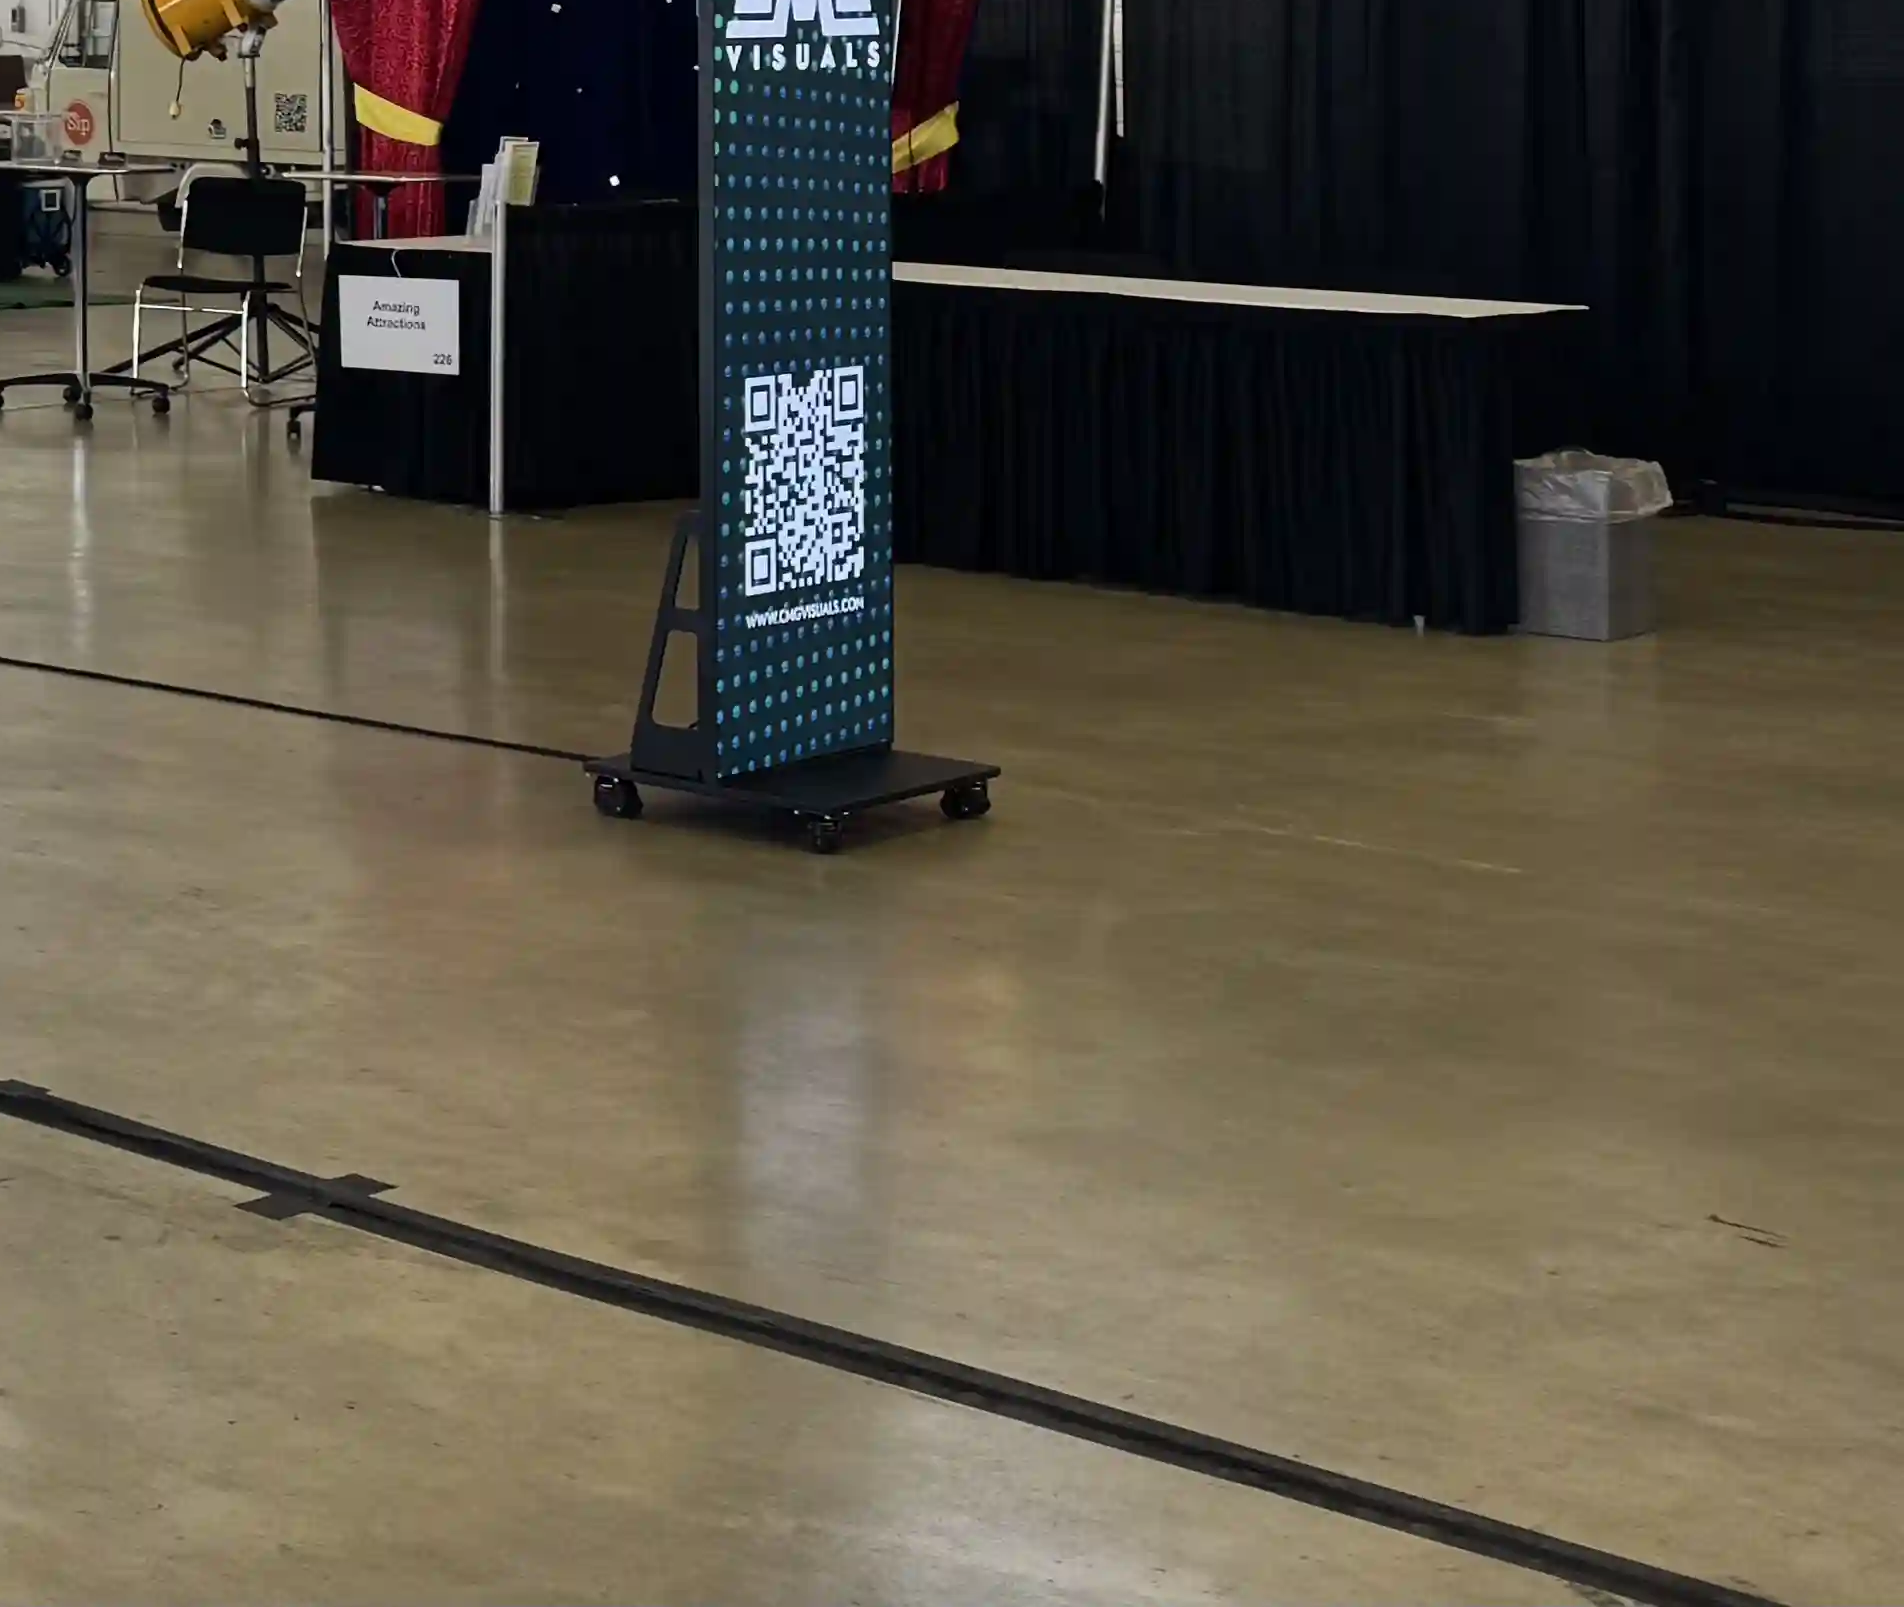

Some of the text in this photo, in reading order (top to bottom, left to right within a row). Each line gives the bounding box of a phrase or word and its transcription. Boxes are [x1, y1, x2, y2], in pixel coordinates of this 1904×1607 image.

[726, 41, 880, 72] VISUALS
[372, 300, 421, 316] Amazing
[366, 315, 427, 331] Attractions
